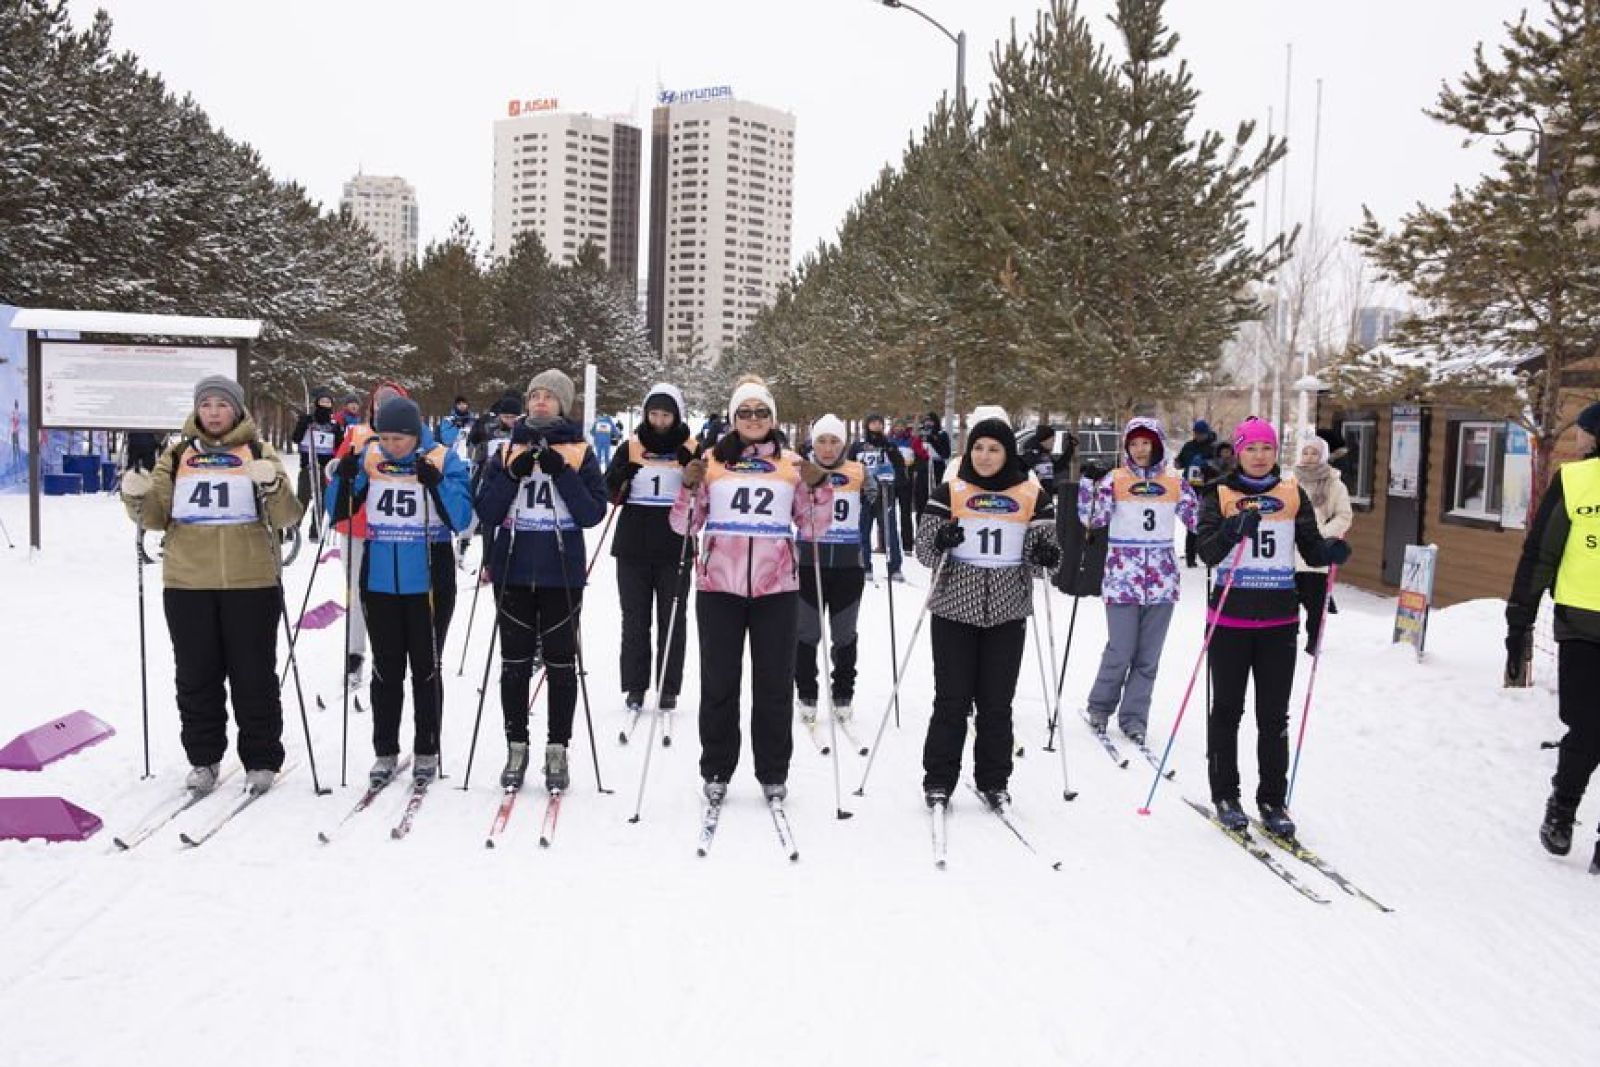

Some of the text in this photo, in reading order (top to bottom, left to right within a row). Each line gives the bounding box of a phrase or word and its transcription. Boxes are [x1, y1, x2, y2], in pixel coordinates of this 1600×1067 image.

[522, 98, 558, 112] JUSAN
[680, 86, 731, 102] HYUNDAI
[188, 481, 230, 508] 41
[523, 480, 555, 510] 14
[650, 475, 661, 496] 1
[376, 489, 417, 518] 45
[730, 487, 775, 516] 42
[833, 499, 850, 522] 9
[1143, 508, 1156, 532] 3
[976, 527, 1003, 556] 11
[1251, 530, 1276, 559] 15
